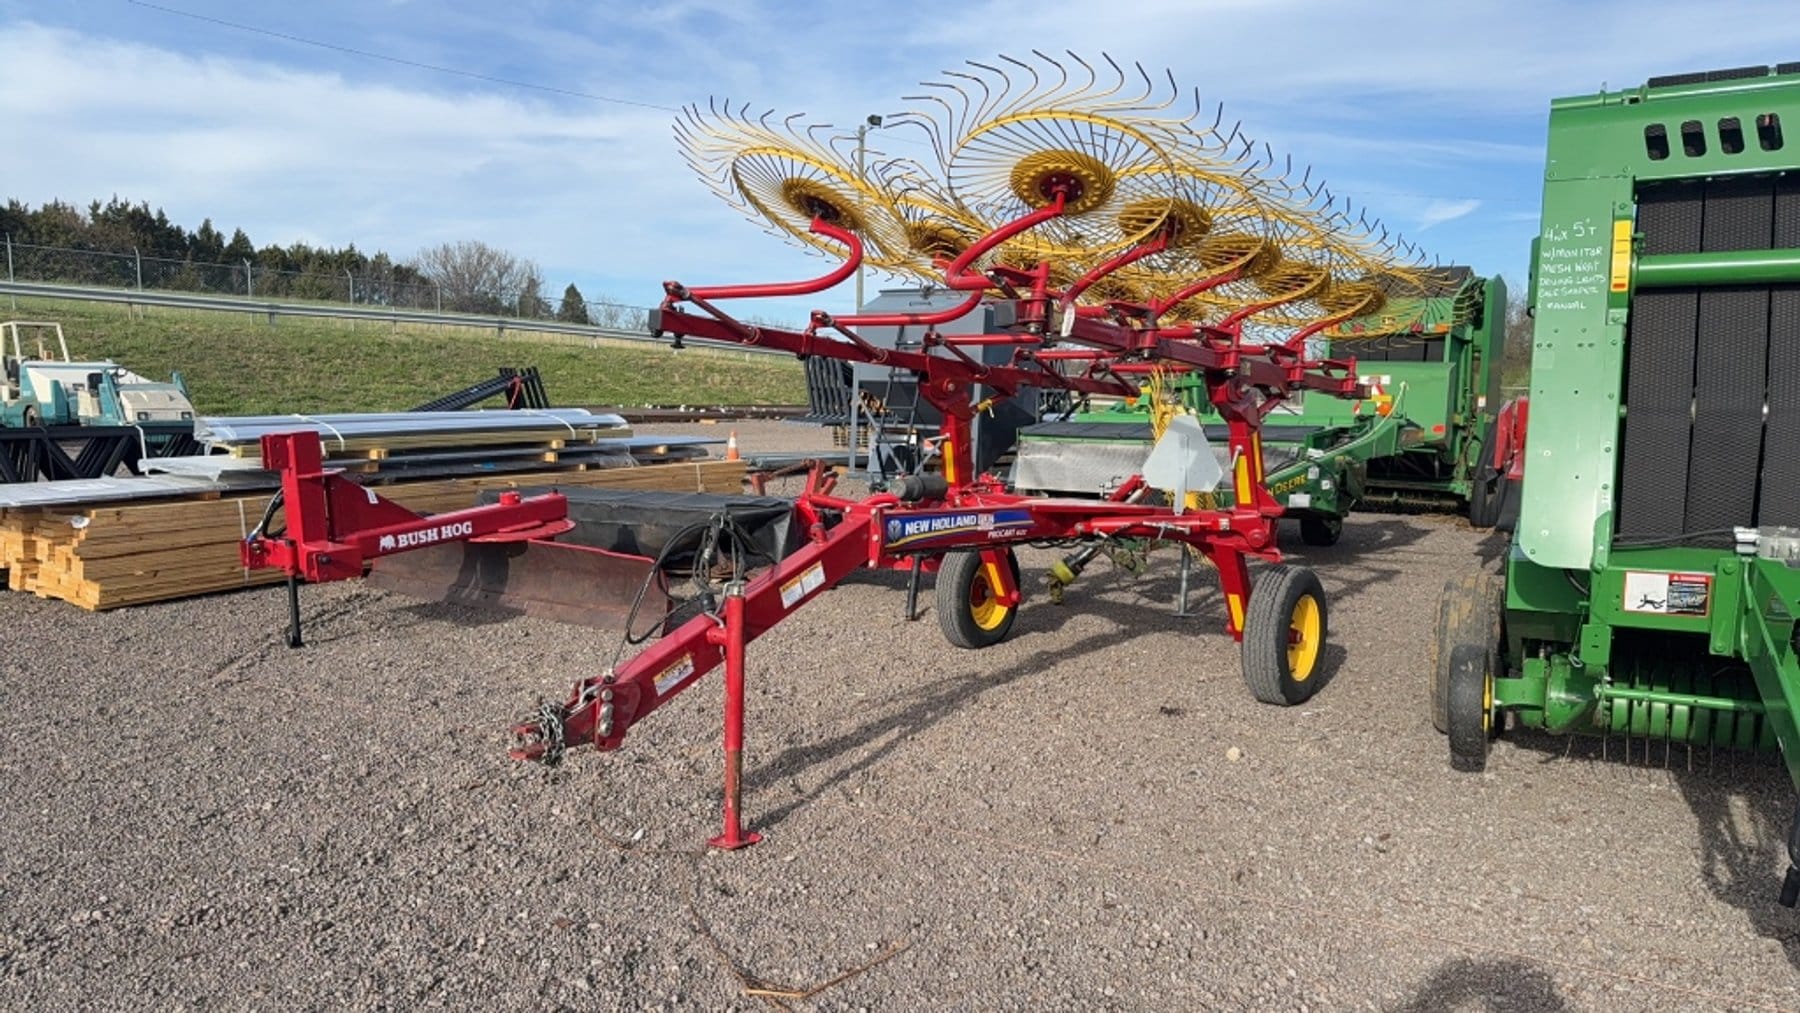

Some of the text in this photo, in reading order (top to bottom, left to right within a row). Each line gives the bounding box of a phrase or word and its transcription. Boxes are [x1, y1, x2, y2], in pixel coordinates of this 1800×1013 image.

[397, 521, 472, 548] BUSH HOG
[905, 519, 930, 536] NEW
[931, 514, 977, 531] HOLLAND
